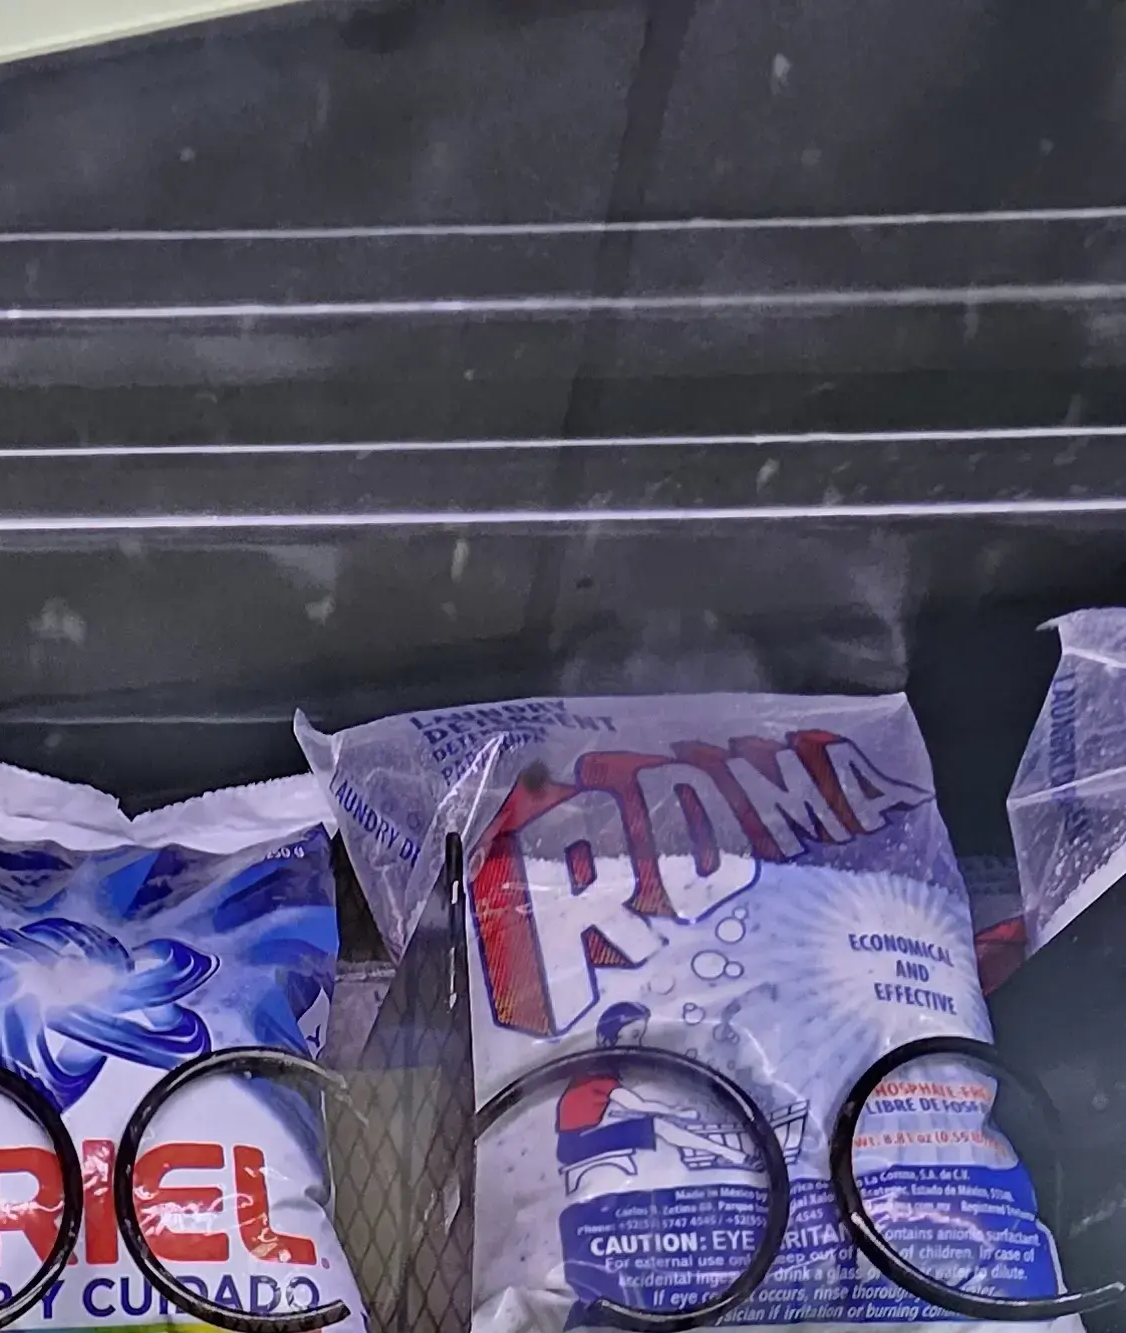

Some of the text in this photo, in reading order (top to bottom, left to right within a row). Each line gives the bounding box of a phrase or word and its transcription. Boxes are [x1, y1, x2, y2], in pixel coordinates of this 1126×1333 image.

[467, 730, 938, 1040] ROMA
[847, 933, 955, 968] ECONOMICAL
[895, 959, 930, 982] AND
[873, 981, 958, 1016] EFFECTIVE
[865, 1097, 941, 1115] LIBRE DE
[590, 1221, 852, 1257] CAUTION: EYE RITAN
[634, 1253, 694, 1269] external
[697, 1256, 724, 1267] use
[24, 1279, 58, 1319] Y
[81, 1275, 321, 1317] CUIDADO
[670, 1292, 698, 1309] eye
[813, 1285, 848, 1300] rinse
[784, 1302, 919, 1321] irritation burning
